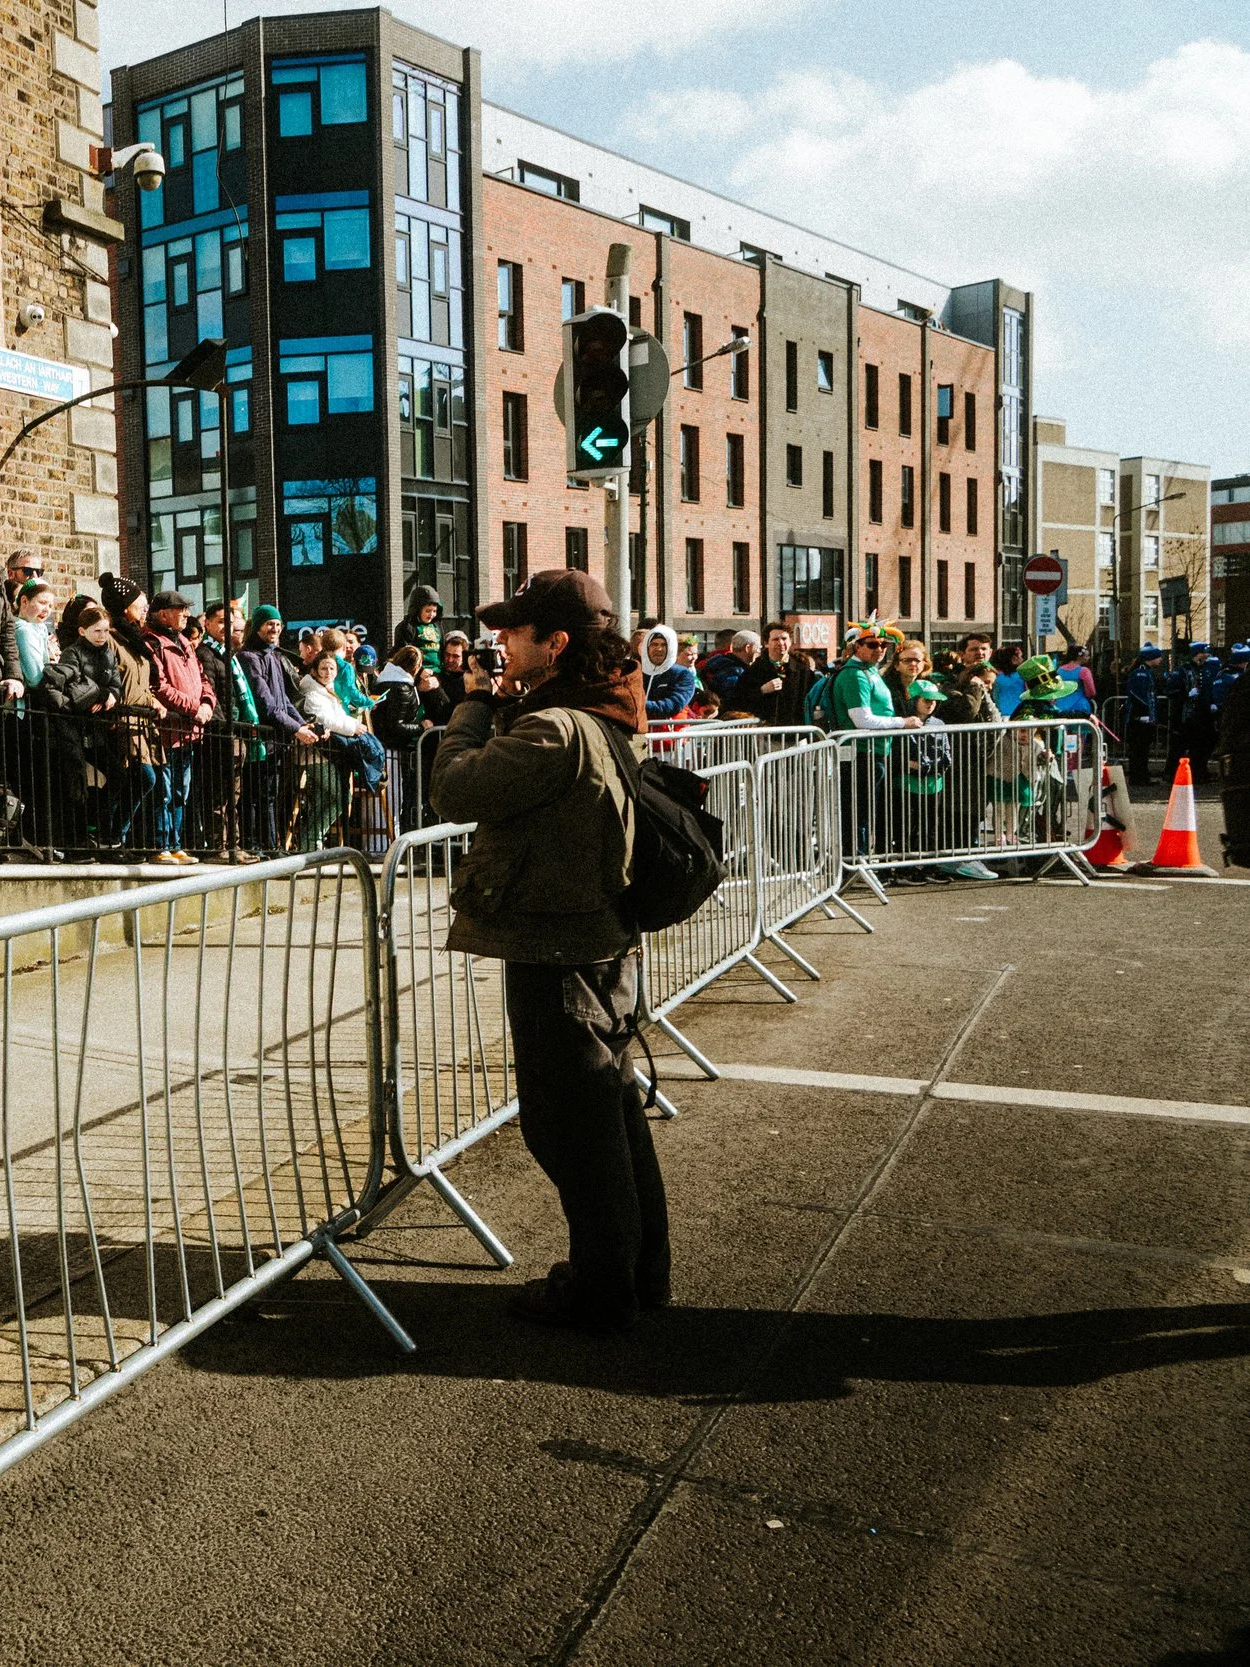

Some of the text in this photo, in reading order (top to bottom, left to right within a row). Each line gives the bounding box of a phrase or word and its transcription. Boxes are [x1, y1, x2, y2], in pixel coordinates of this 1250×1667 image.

[24, 362, 35, 374] AN
[44, 381, 60, 393] WAY
[793, 617, 830, 646] node
